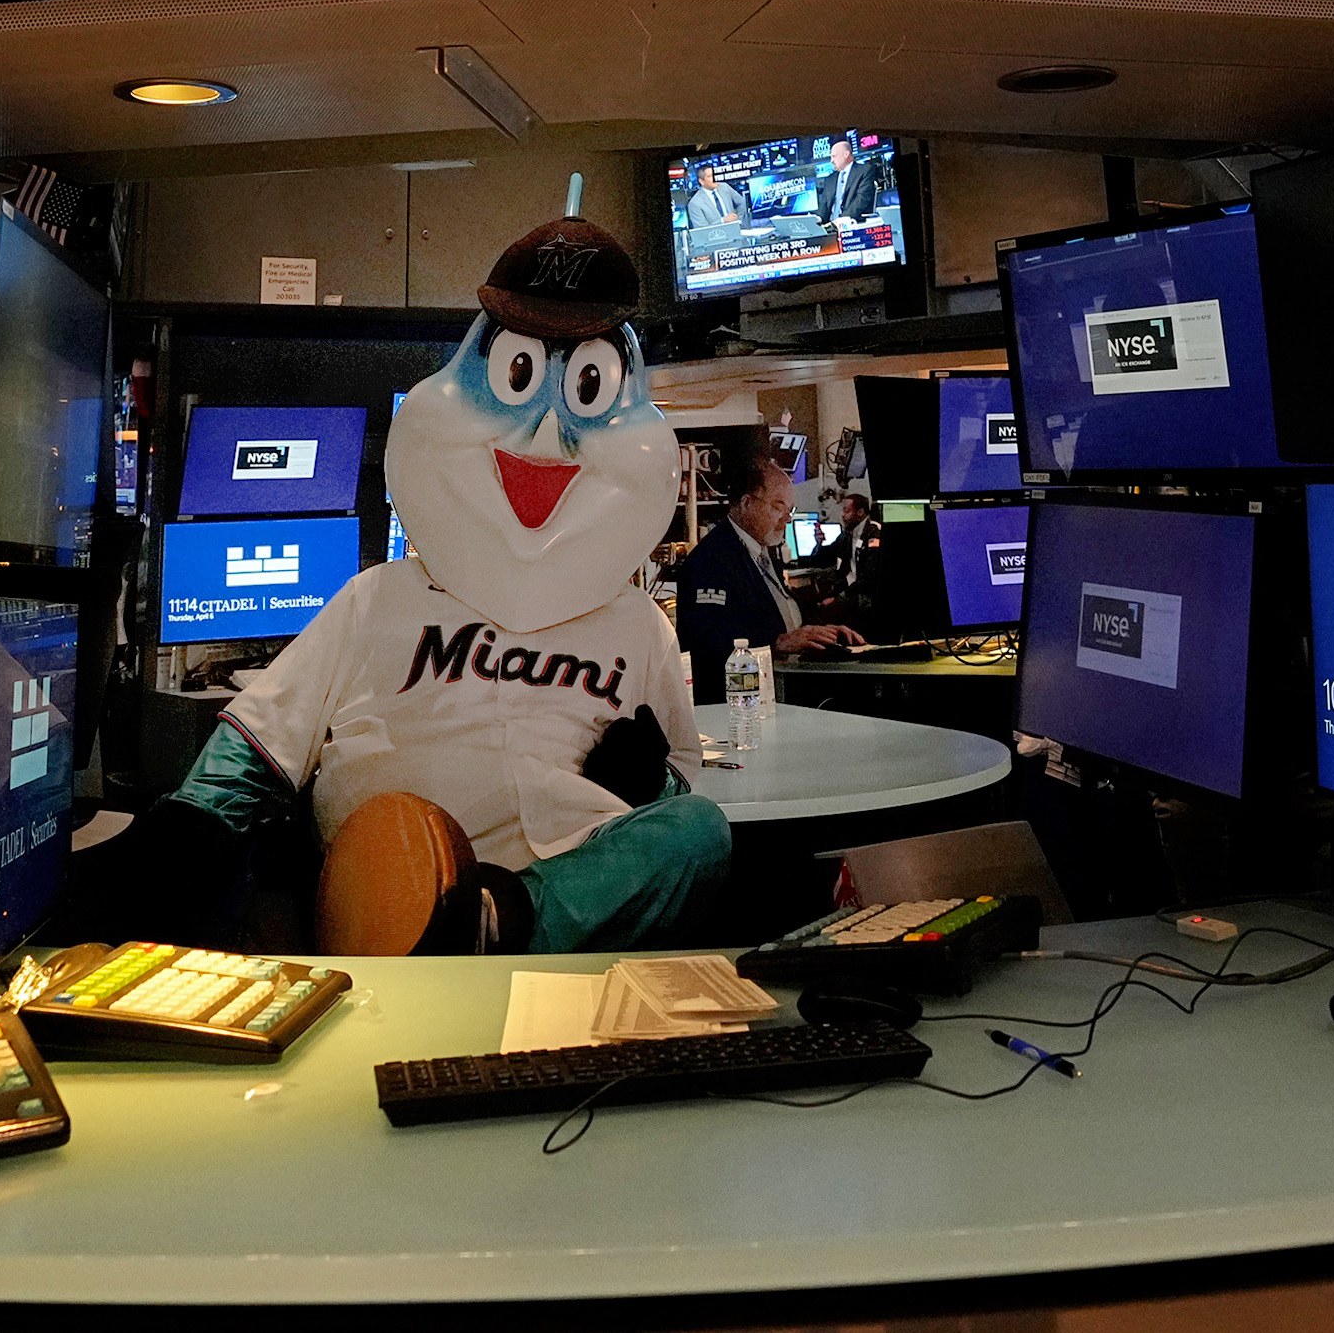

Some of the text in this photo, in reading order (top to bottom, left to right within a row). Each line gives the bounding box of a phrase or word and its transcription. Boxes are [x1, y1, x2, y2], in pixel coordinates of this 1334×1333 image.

[719, 240, 806, 259] DOW TRYING FOR 3RD
[719, 256, 755, 268] POSITIVE
[756, 252, 781, 262] WEEK
[799, 246, 822, 257] ROW
[397, 621, 627, 712] Miami
